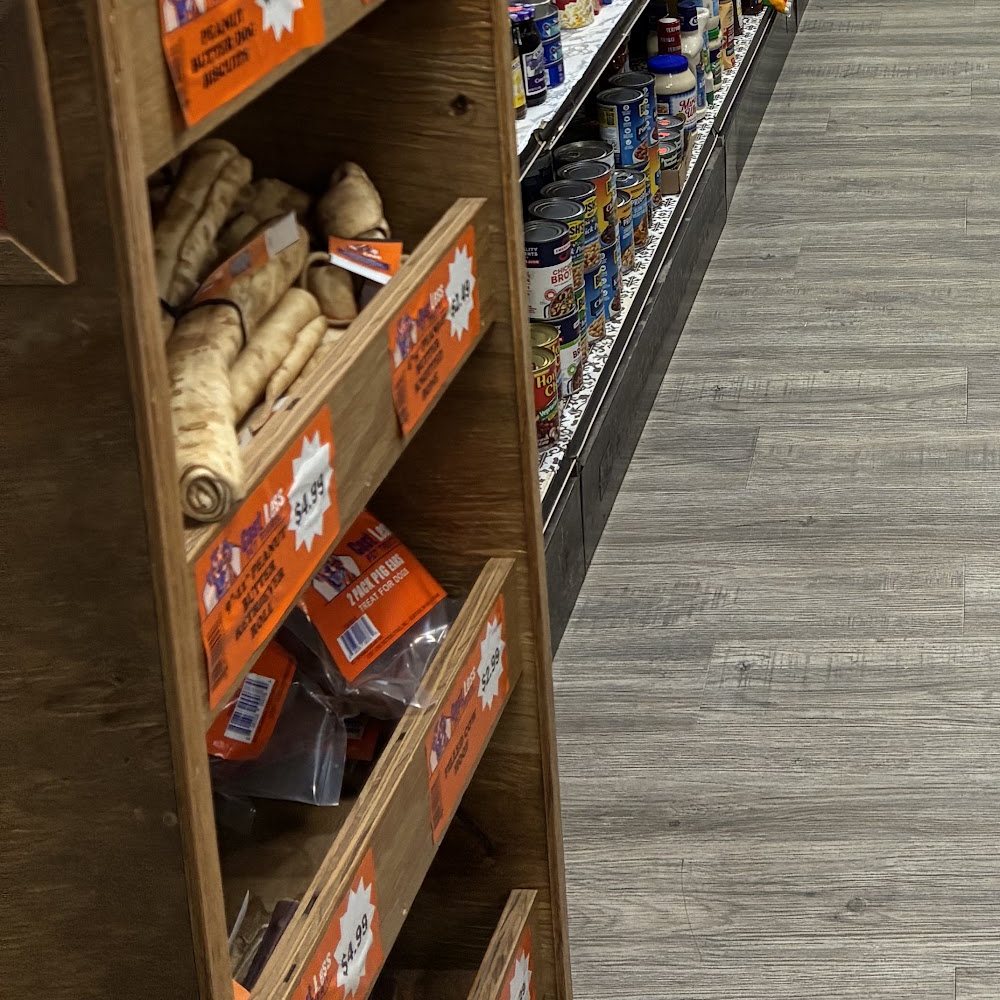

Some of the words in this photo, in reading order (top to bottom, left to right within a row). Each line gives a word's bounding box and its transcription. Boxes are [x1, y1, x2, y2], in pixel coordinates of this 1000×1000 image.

[190, 36, 231, 73] BUTTER
[232, 23, 254, 48] DOG
[199, 8, 243, 45] PEANUT
[262, 480, 284, 527] Less
[293, 470, 325, 530] $4.99
[250, 522, 287, 581] PEANUT
[242, 558, 275, 613] BUTTER
[347, 594, 356, 607] 2
[354, 578, 375, 602] PACK
[371, 565, 391, 585] PIG
[386, 553, 406, 573] EARS
[358, 593, 379, 612] TREAT
[379, 581, 395, 597] FOR
[394, 567, 410, 584] DOGS
[251, 598, 273, 639] ROLL
[480, 647, 501, 694] $2.99
[339, 914, 369, 977] $4.99
